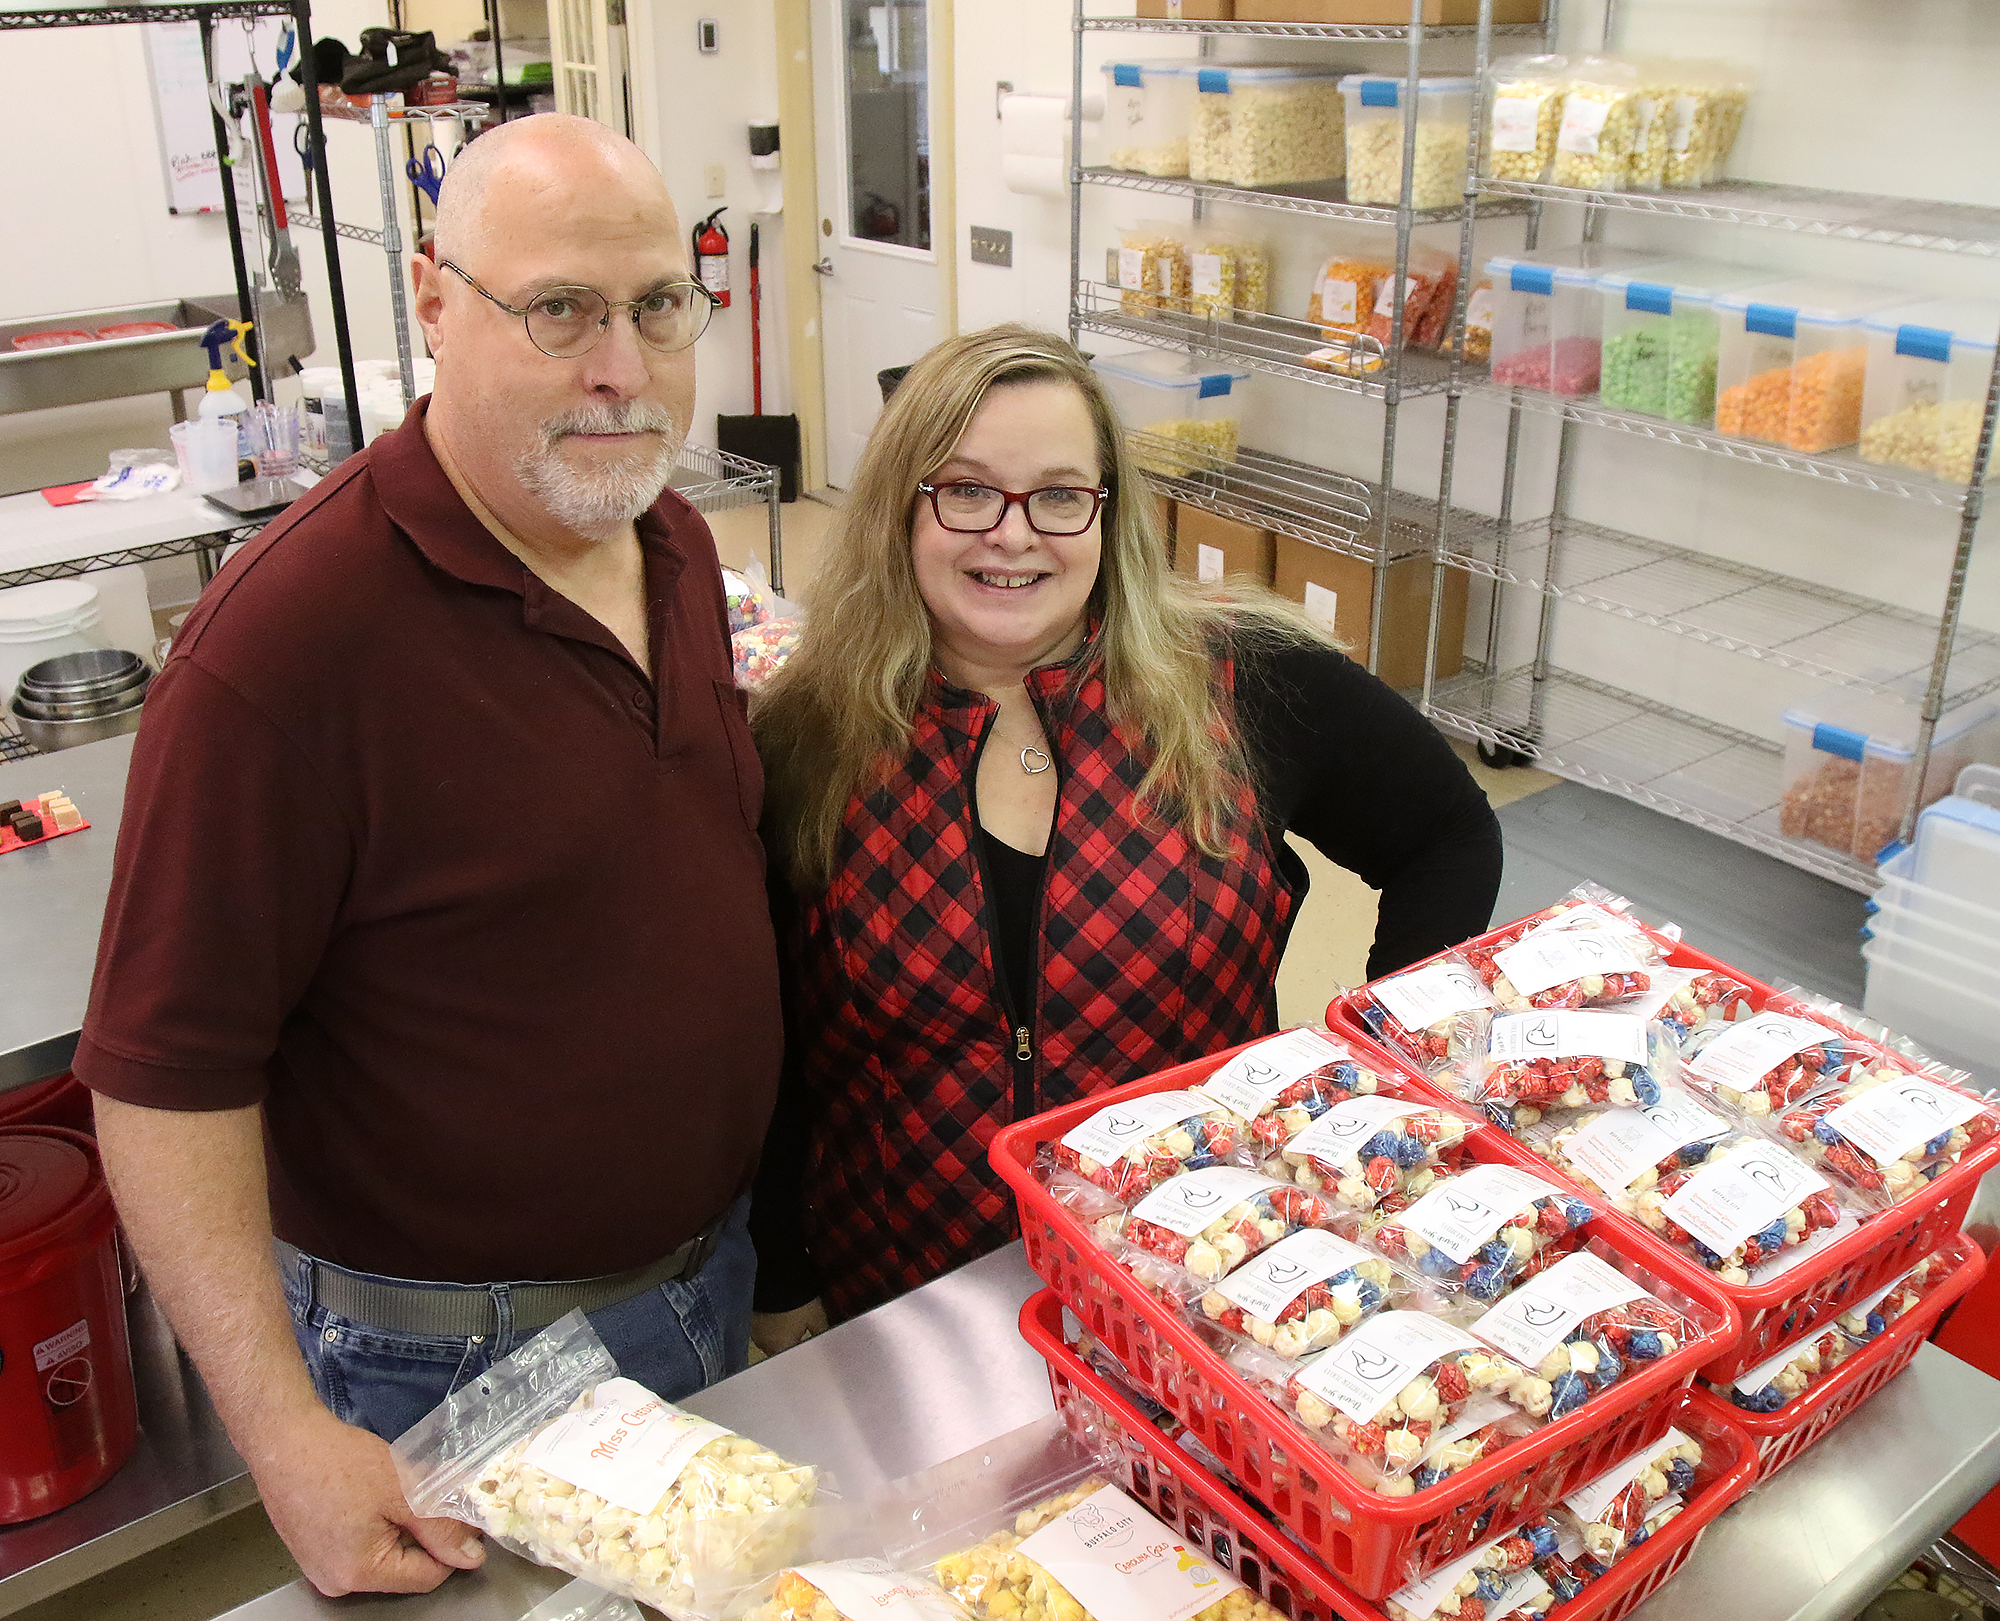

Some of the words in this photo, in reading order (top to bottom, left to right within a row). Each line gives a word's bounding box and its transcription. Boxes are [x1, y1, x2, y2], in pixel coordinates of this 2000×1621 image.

[45, 1322, 87, 1350] WARNING
[590, 1428, 628, 1460] MISS
[1084, 1526, 1118, 1549] BUFFALO
[1116, 1516, 1134, 1529] CITY
[1114, 1550, 1150, 1575] CAROLINA
[1145, 1542, 1170, 1559] GOLD
